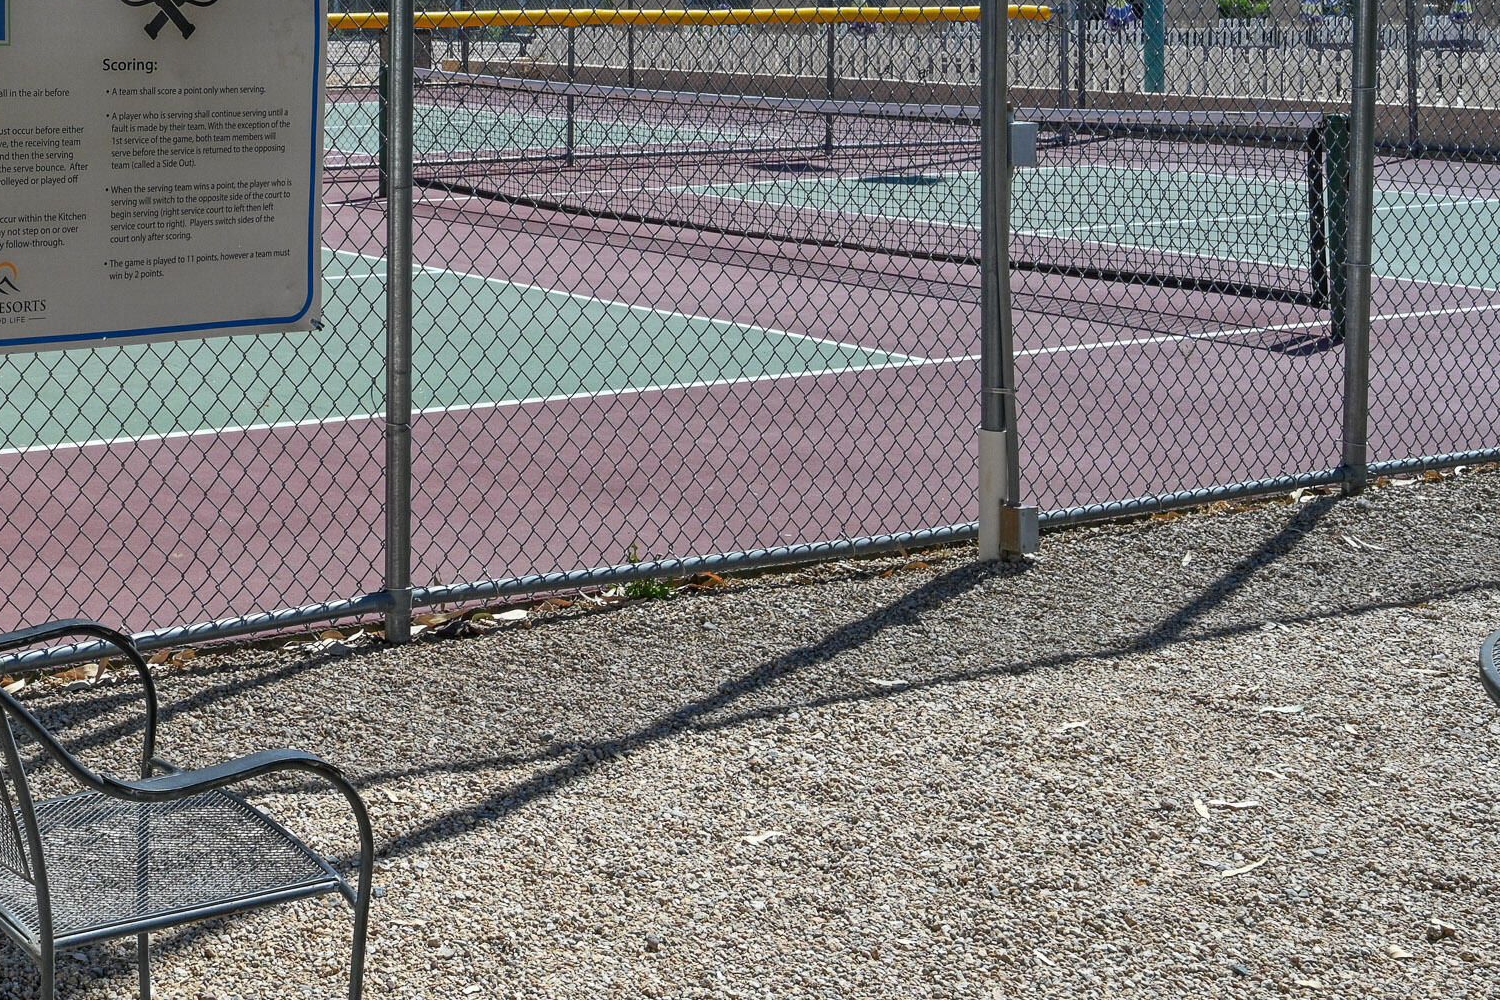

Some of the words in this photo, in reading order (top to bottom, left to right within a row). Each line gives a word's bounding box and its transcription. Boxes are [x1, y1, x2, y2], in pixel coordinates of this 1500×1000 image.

[103, 58, 158, 74] Scoring:
[18, 89, 32, 97] the
[33, 89, 43, 97] air
[44, 88, 70, 97] before
[139, 87, 156, 95] shall
[183, 87, 202, 96] point
[203, 86, 219, 95] only
[18, 214, 42, 222] within
[44, 213, 57, 222] the
[58, 212, 87, 221] Kitchen
[6, 228, 21, 237] not
[22, 228, 39, 239] step
[52, 227, 60, 236] or
[5, 238, 65, 248] follow-through.
[109, 259, 124, 268] The
[124, 260, 145, 269] game
[152, 256, 176, 267] played
[124, 271, 134, 280] by
[134, 270, 139, 279] 2
